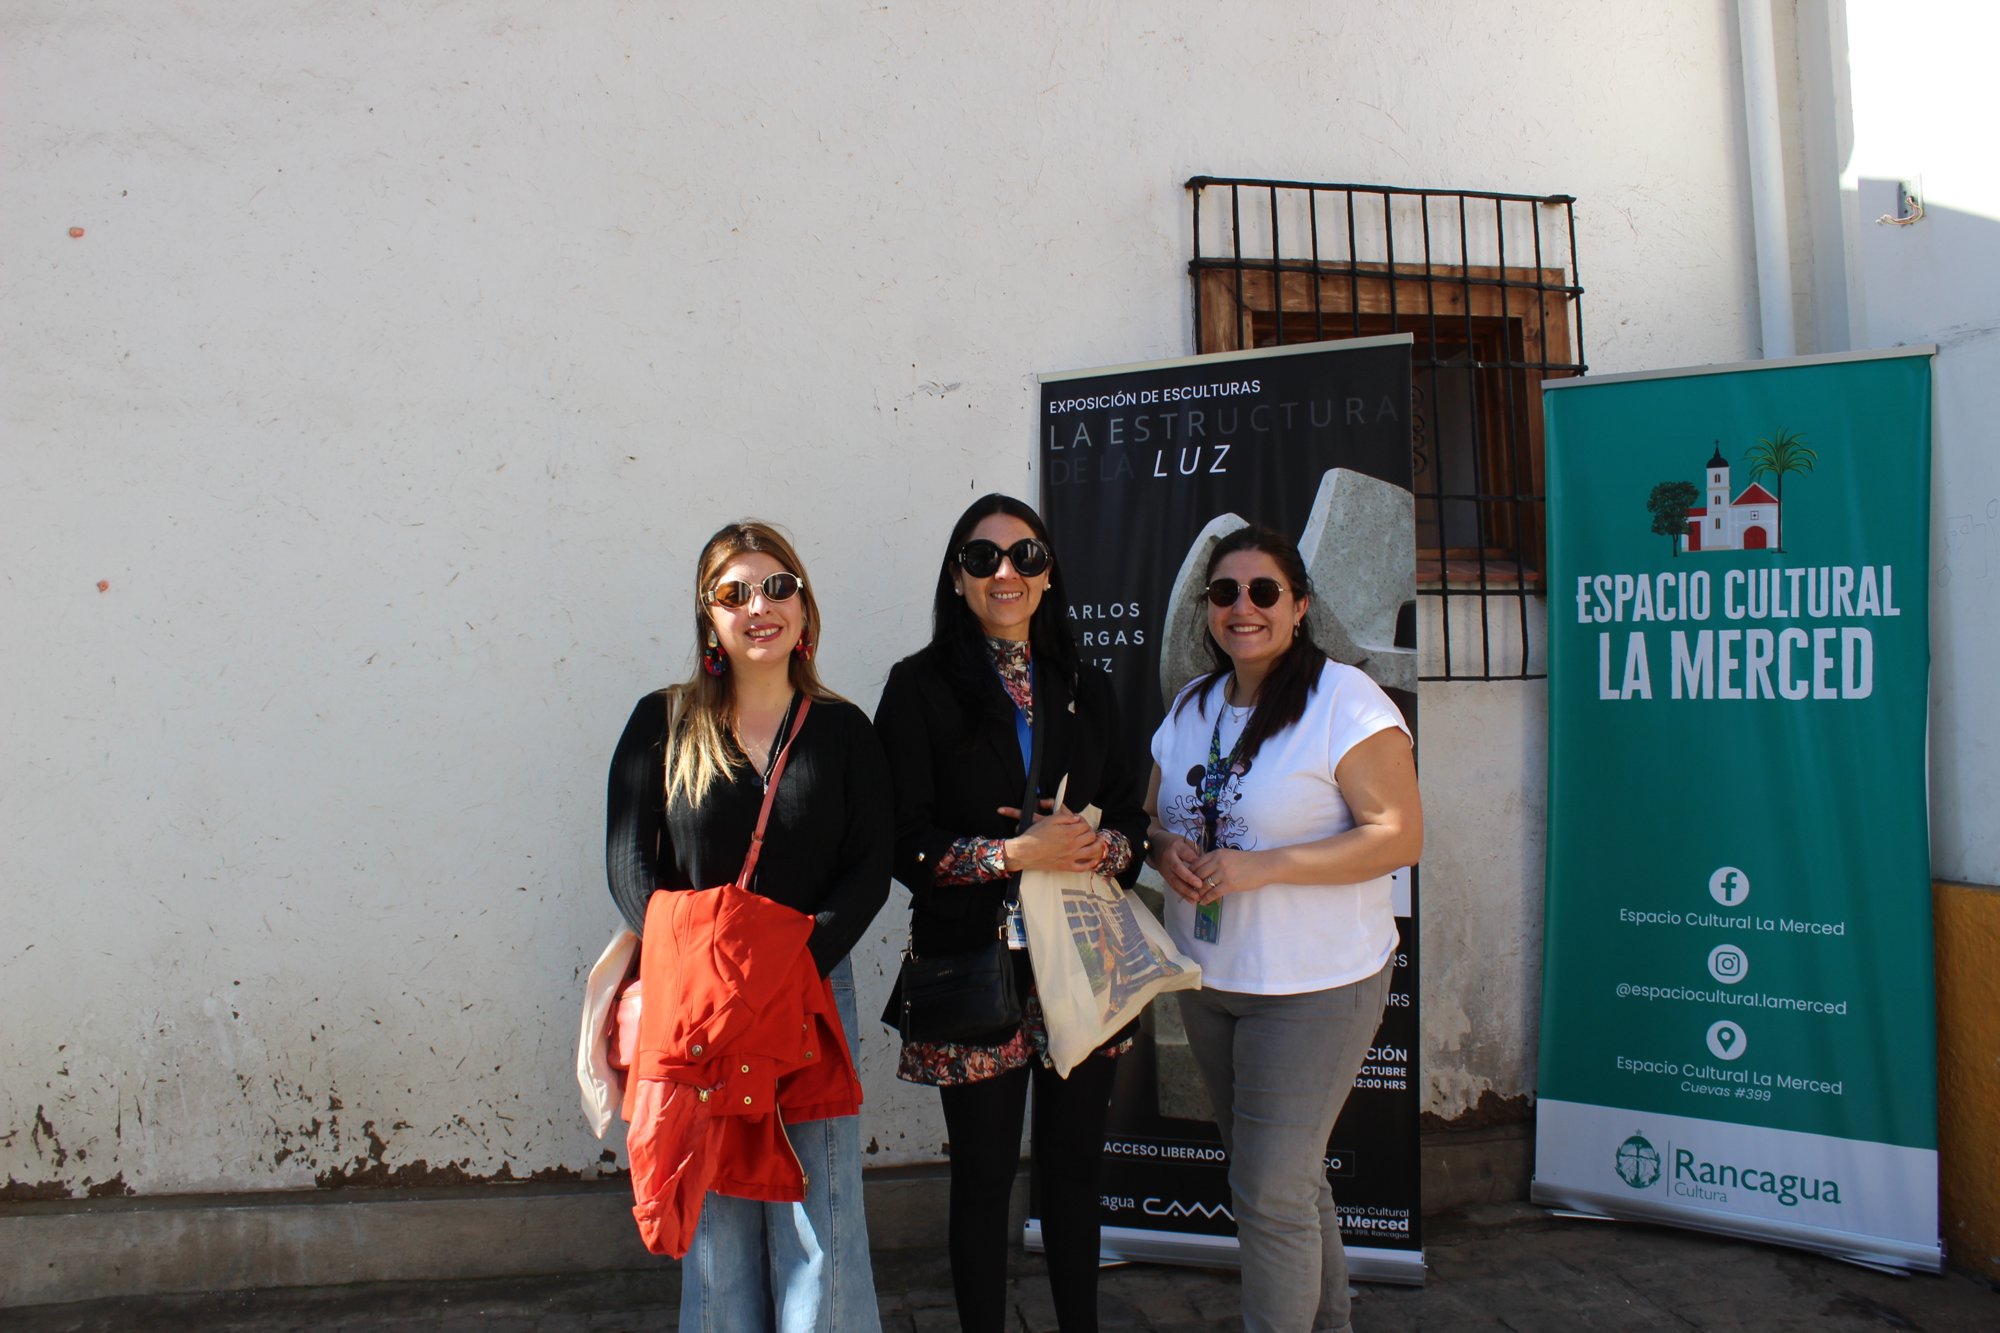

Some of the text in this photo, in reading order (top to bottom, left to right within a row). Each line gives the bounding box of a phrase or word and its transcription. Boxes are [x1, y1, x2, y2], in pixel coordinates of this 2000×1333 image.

[1050, 380, 1261, 414] EXPOSICIÓN DE ESCULTURAS
[1050, 393, 1399, 450] LA ESTRUCTURA
[1153, 445, 1231, 477] LUZ
[1576, 565, 1900, 623] ESPACIO CULTURAL
[1067, 603, 1140, 620] ARLOS
[1075, 630, 1144, 647] RGAS
[1600, 627, 1873, 700] LA MERCED
[1620, 908, 1845, 936] Espacio Cultural La Merced
[1616, 983, 1847, 1015] @espaciocultural.lamerced
[1383, 1080, 1407, 1090] HRS
[1617, 1056, 1842, 1095] Espacio Cultural La Merced
[1680, 1081, 1772, 1102] Cuevas #399
[1103, 1142, 1226, 1161] ACCESO LIBERADO
[1674, 1148, 1842, 1206] Rancagua
[1674, 1181, 1728, 1202] Cultura
[1335, 1205, 1409, 1217] pacio Cultural
[1346, 1215, 1409, 1232] Merced
